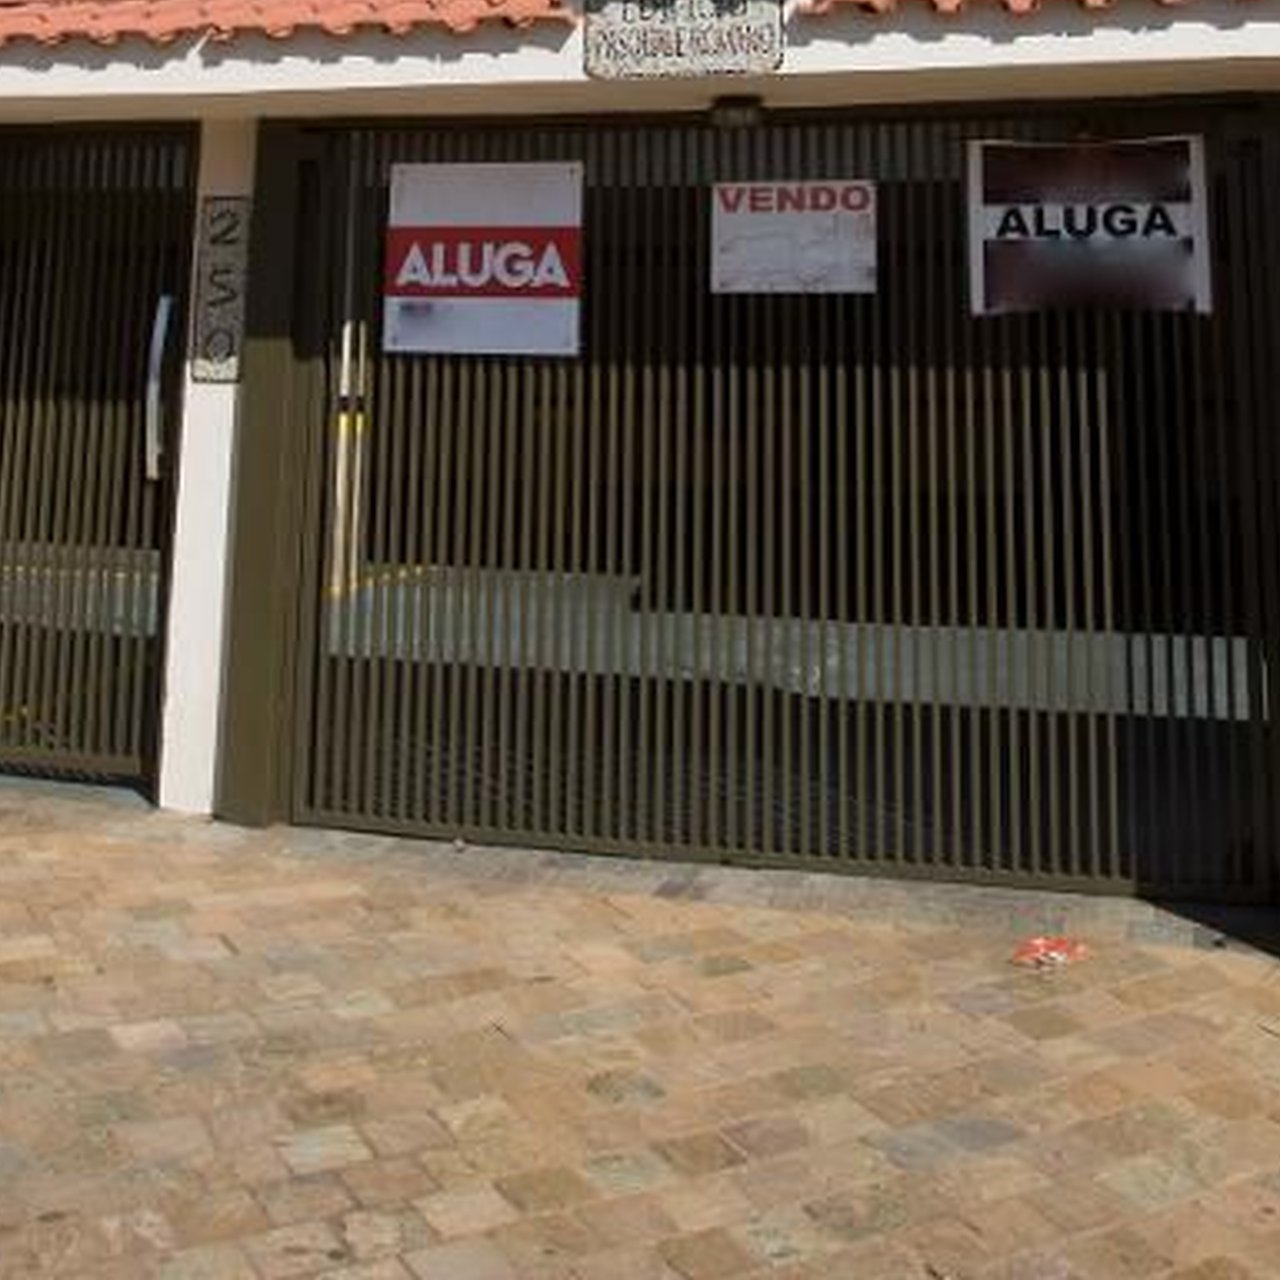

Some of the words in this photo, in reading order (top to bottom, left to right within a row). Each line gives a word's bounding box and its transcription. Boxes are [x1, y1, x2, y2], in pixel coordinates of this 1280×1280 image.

[718, 184, 871, 214] VENDO
[996, 204, 1178, 239] ALUGA
[395, 241, 570, 288] ALUGA
